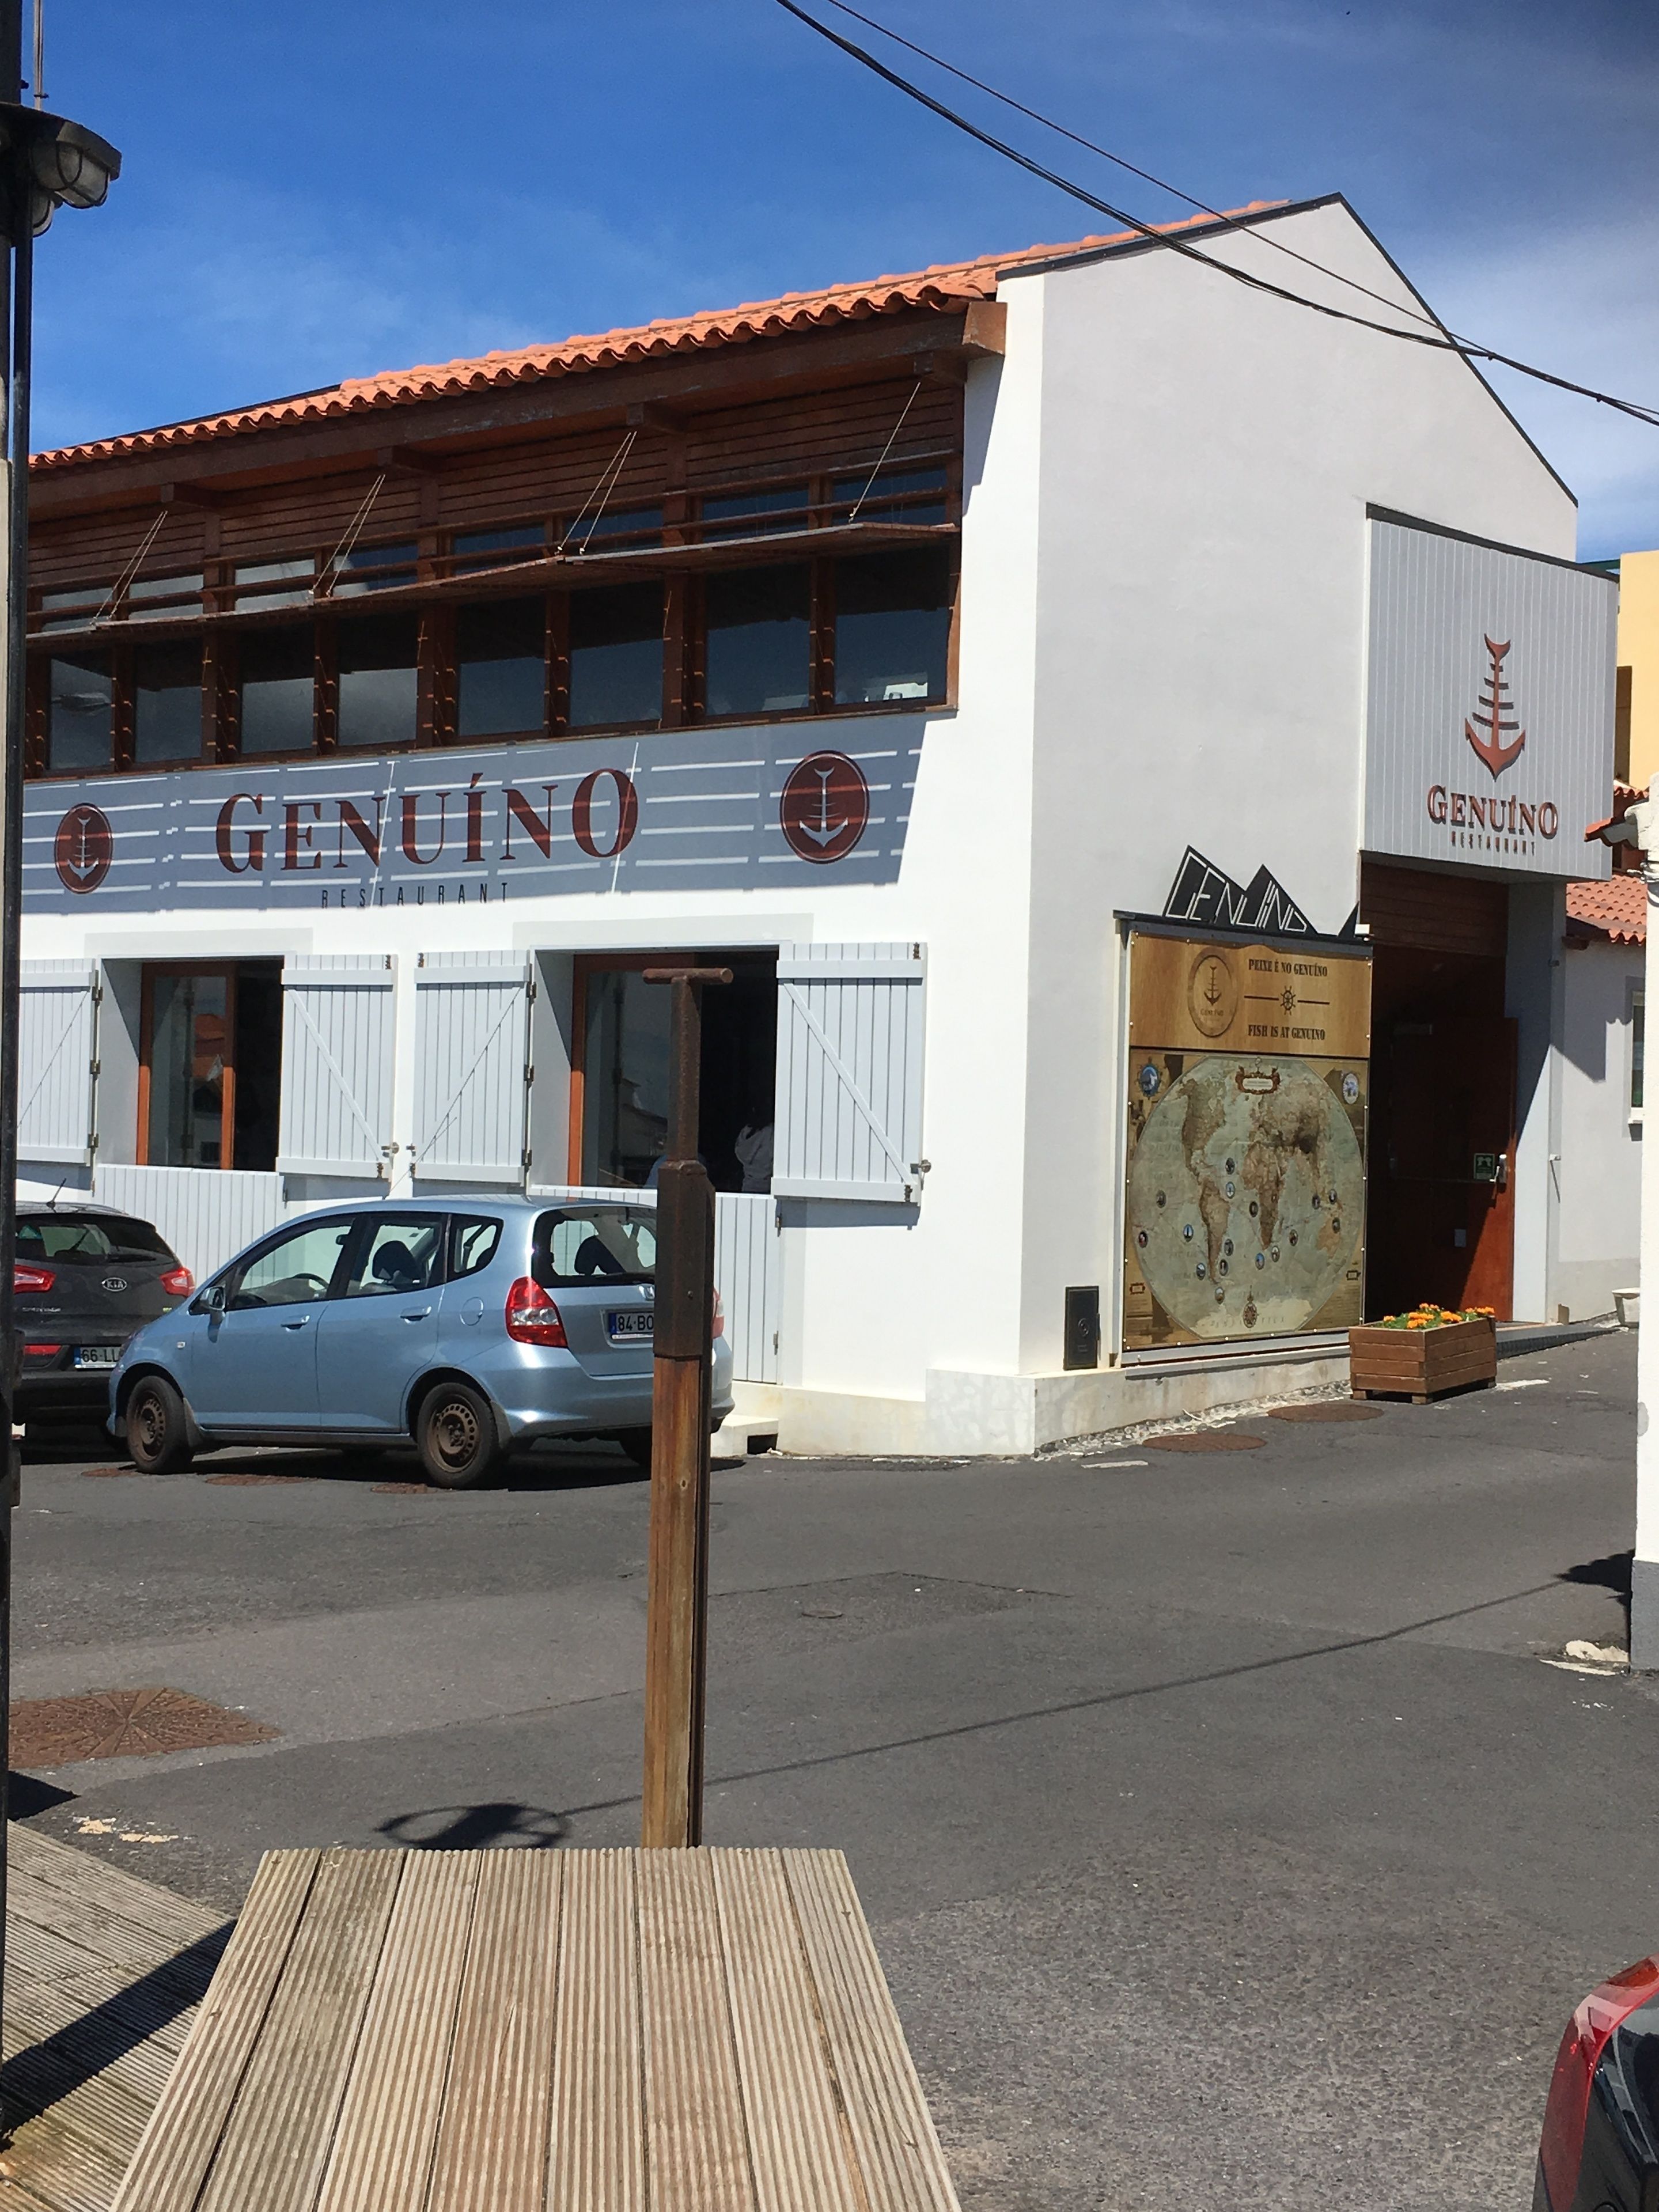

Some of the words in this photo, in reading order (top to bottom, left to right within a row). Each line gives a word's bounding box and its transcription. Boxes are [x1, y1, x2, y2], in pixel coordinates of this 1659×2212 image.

[215, 768, 638, 873] GENUÍNO
[321, 882, 508, 908] RESTAURANT
[1248, 959, 1272, 972] PEIXE
[1281, 962, 1292, 975] NO
[1248, 1025, 1268, 1037] FISH
[1270, 1025, 1279, 1037] IS
[1281, 1027, 1290, 1039] AT
